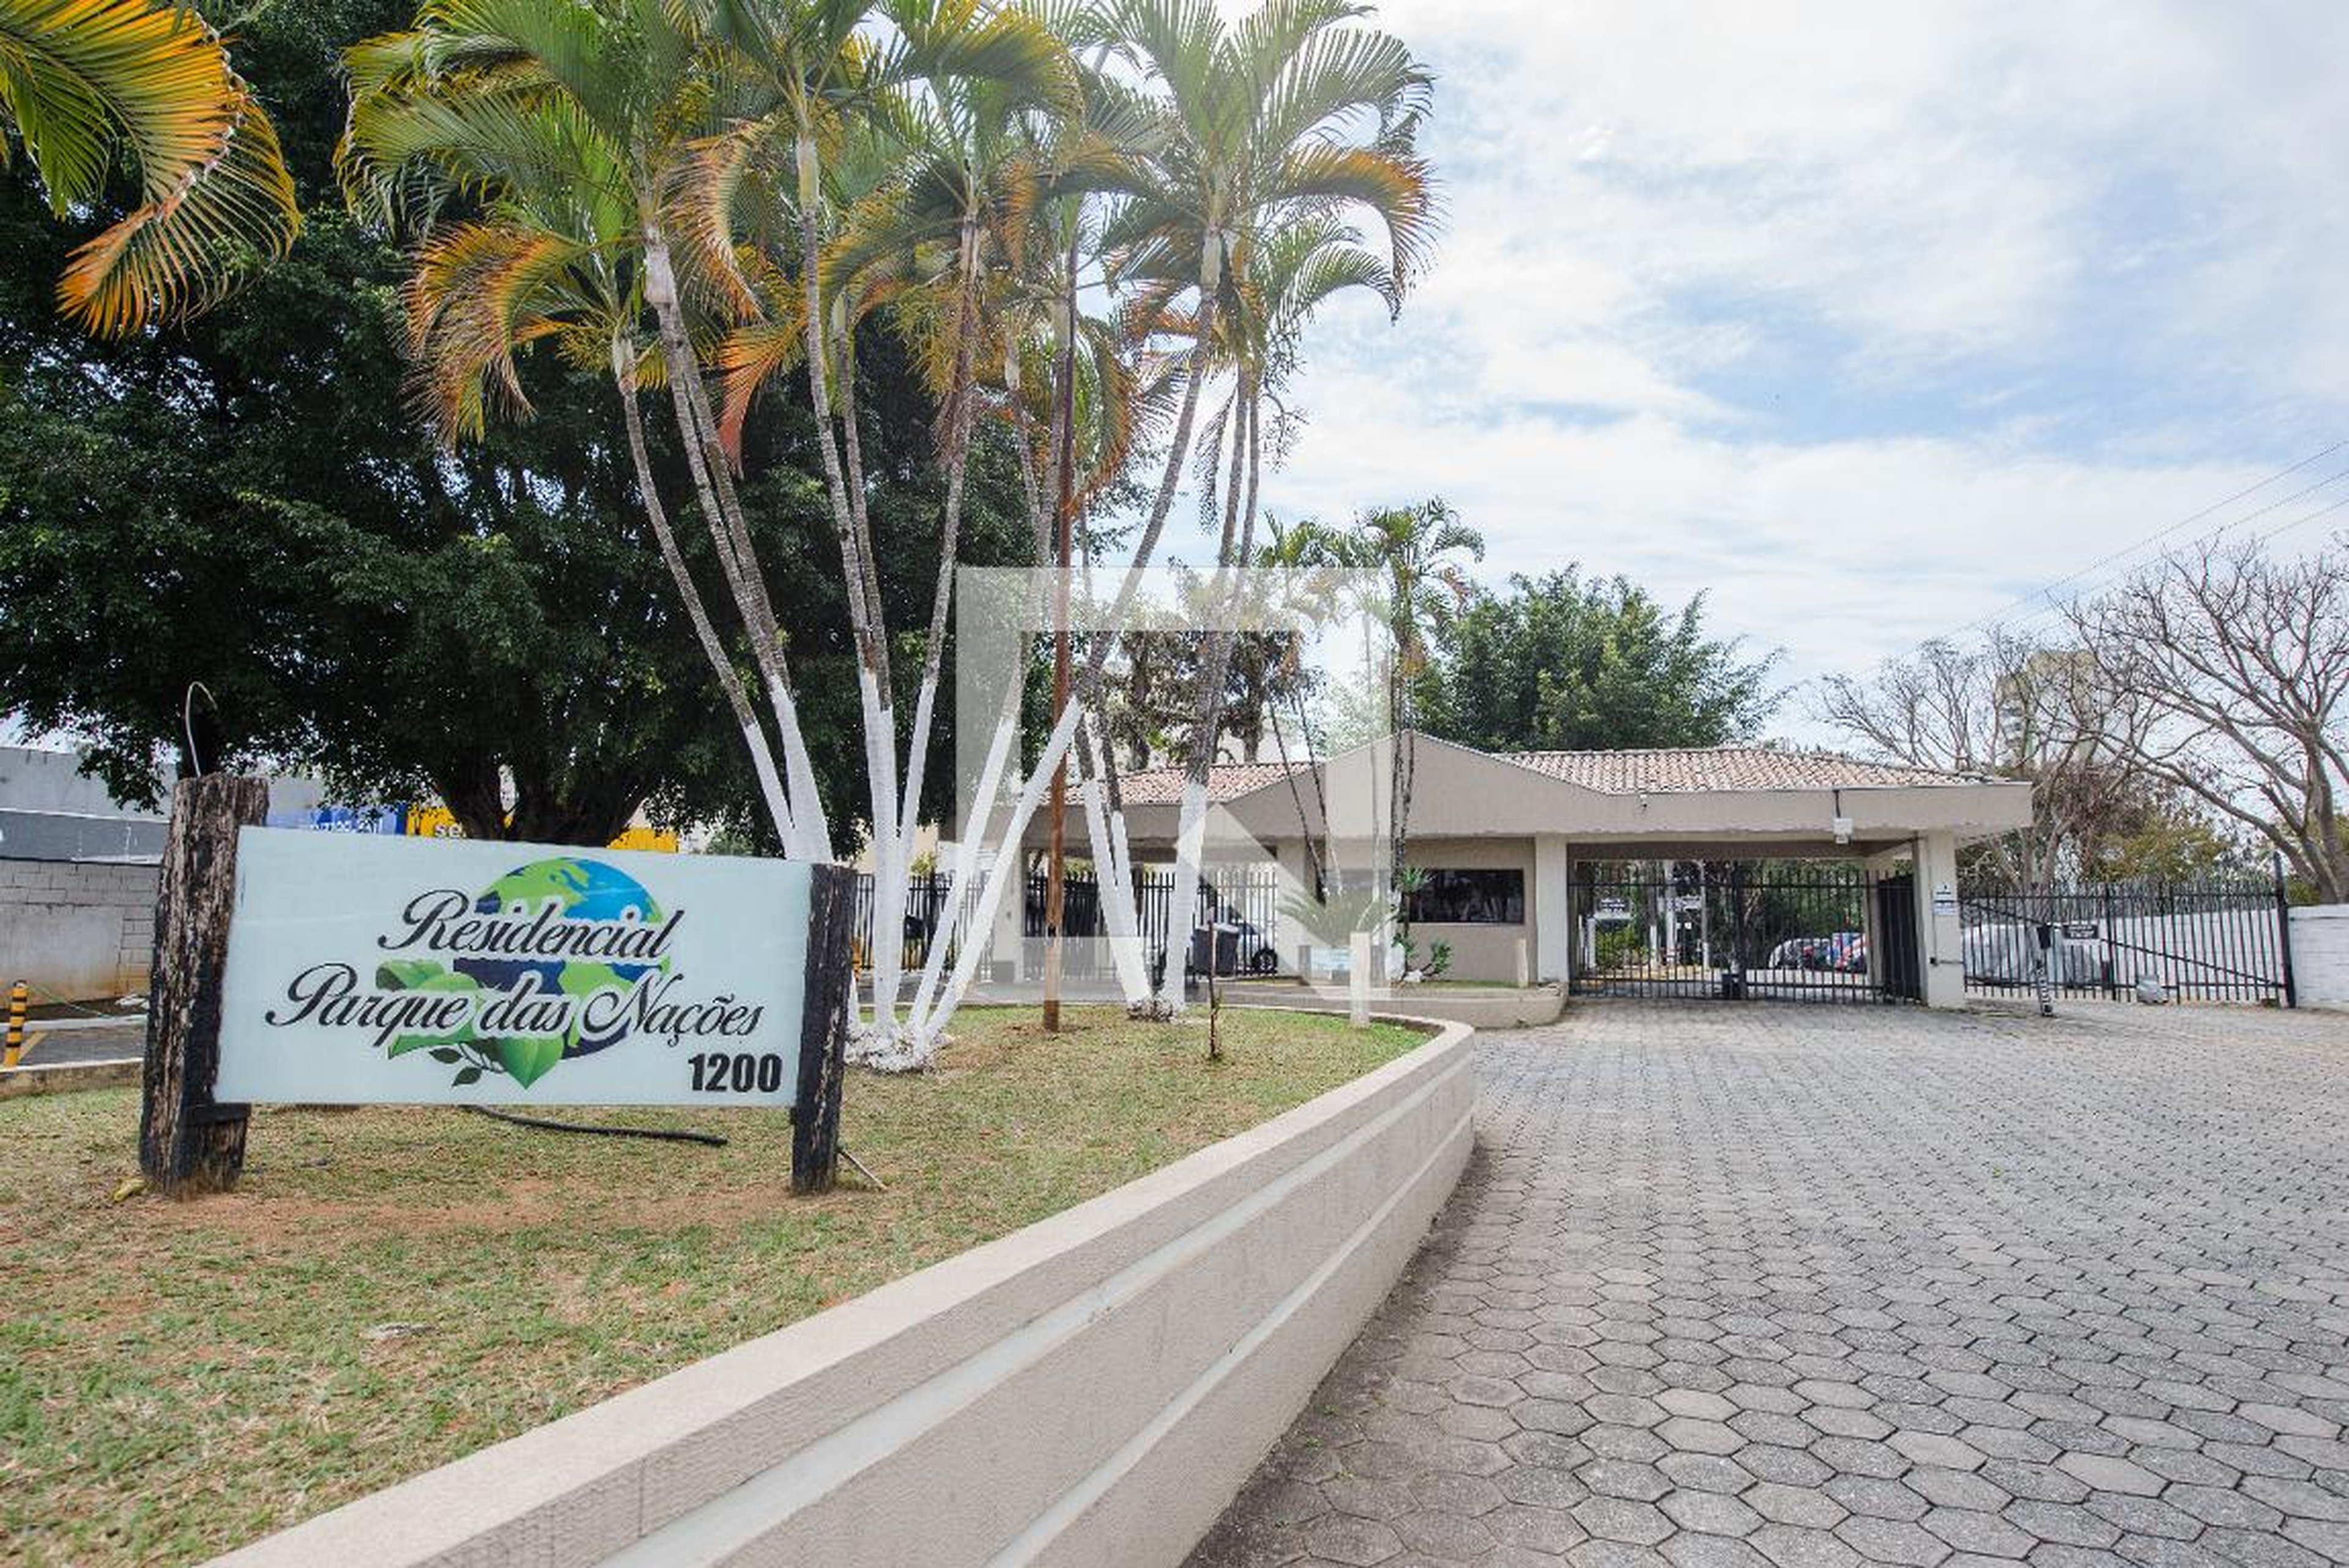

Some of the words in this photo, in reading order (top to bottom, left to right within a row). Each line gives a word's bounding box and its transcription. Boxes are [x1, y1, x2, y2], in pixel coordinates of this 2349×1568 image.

[377, 889, 685, 960] Residencial
[265, 963, 469, 1047] Parque
[479, 978, 570, 1032] das
[583, 974, 765, 1046] Nações
[688, 1052, 783, 1093] 1200
